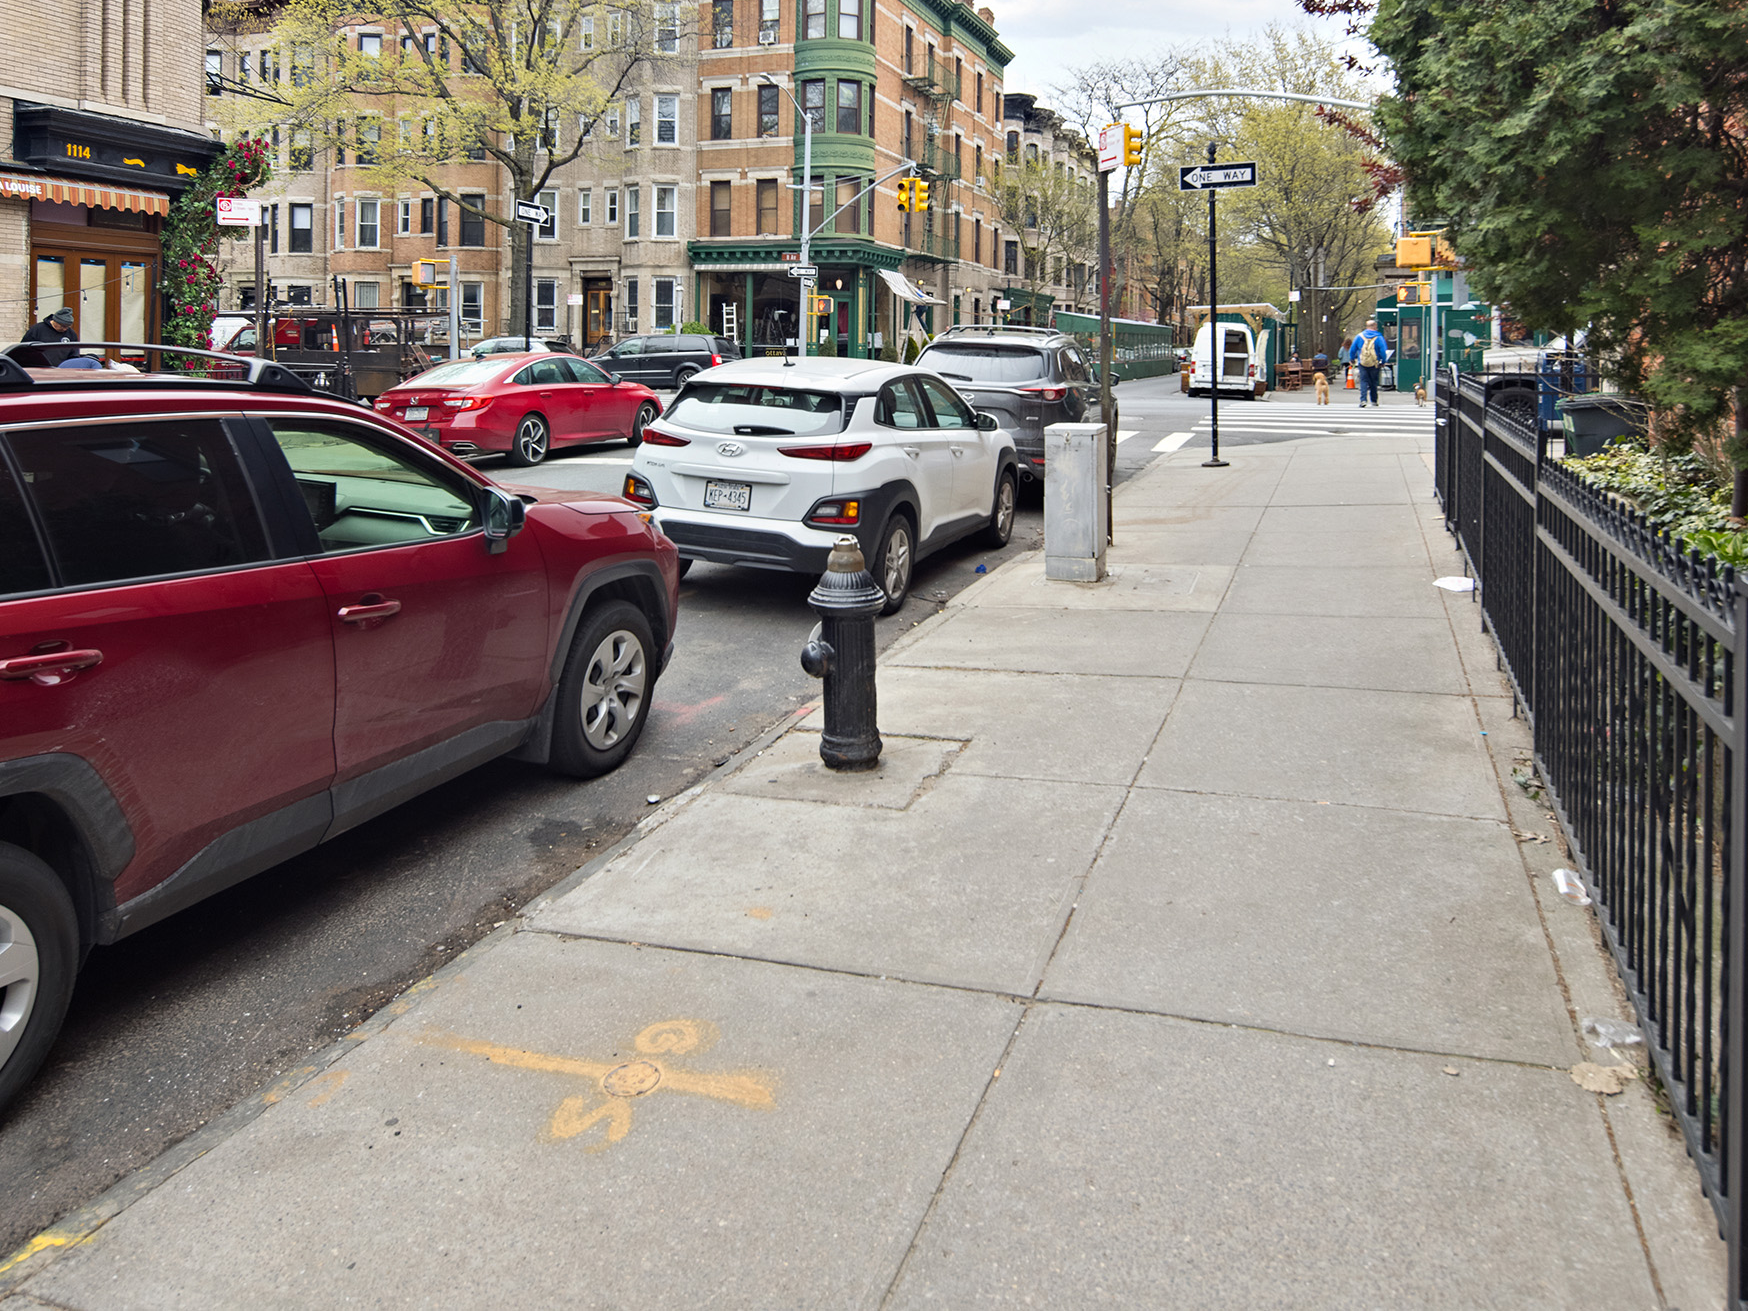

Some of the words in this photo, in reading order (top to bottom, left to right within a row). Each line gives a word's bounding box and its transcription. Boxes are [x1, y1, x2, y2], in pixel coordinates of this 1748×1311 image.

[66, 143, 91, 159] 1114
[1191, 172, 1213, 183] ONE
[1223, 170, 1247, 181] WAY
[5, 182, 42, 195] LOUISE
[521, 207, 531, 216] ONE
[534, 210, 545, 218] WAY
